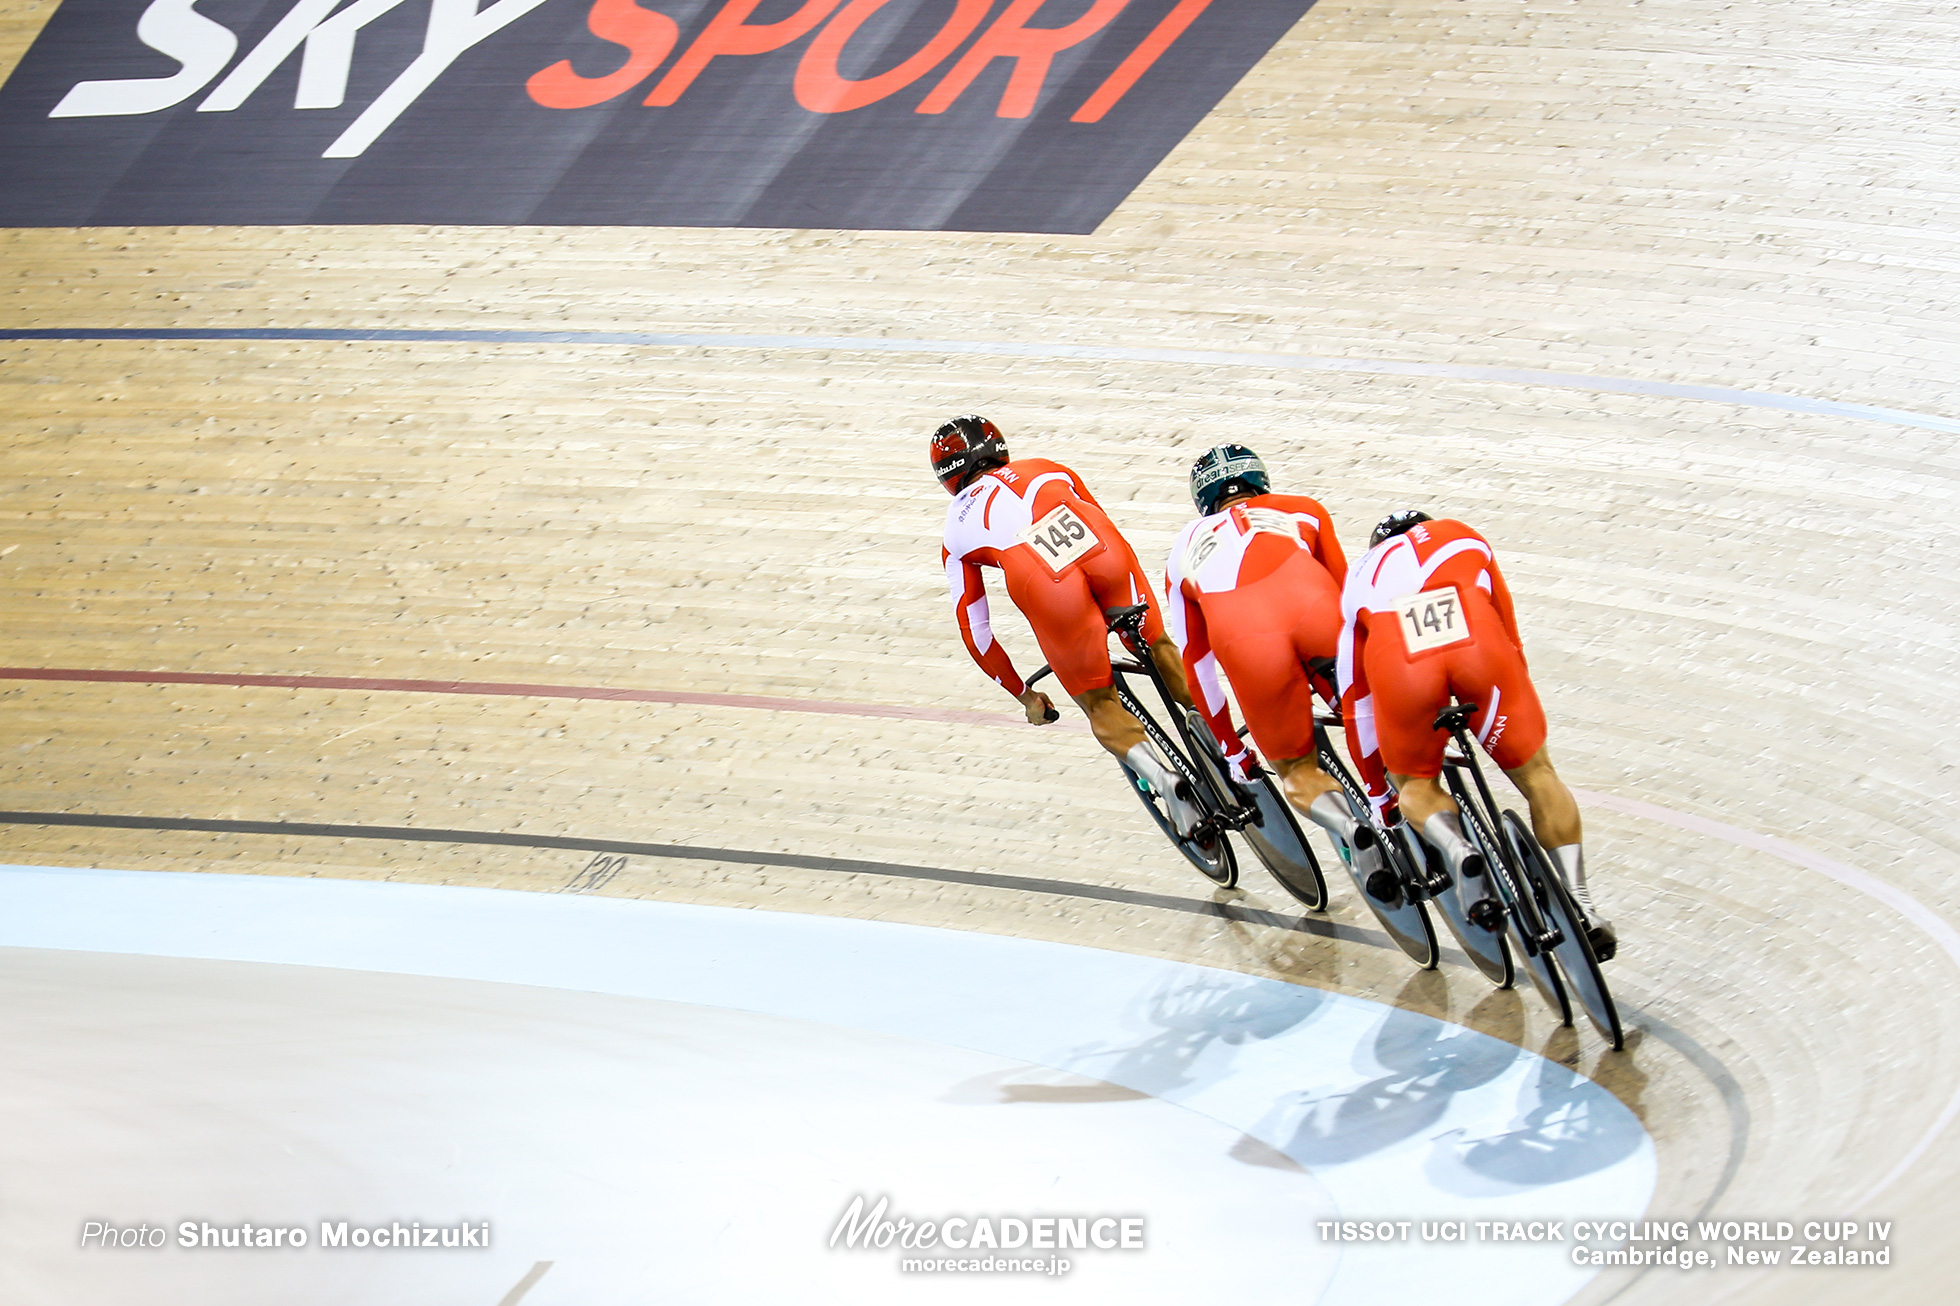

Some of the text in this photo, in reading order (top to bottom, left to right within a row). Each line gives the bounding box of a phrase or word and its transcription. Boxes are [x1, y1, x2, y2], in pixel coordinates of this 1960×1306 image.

[48, 0, 548, 158] SKY
[1033, 513, 1086, 558] 145
[1405, 598, 1456, 637] 147
[1117, 690, 1199, 787] BRIDGESTONE
[1486, 715, 1508, 755] JAPAN
[1320, 750, 1396, 855] BRIDGESNE
